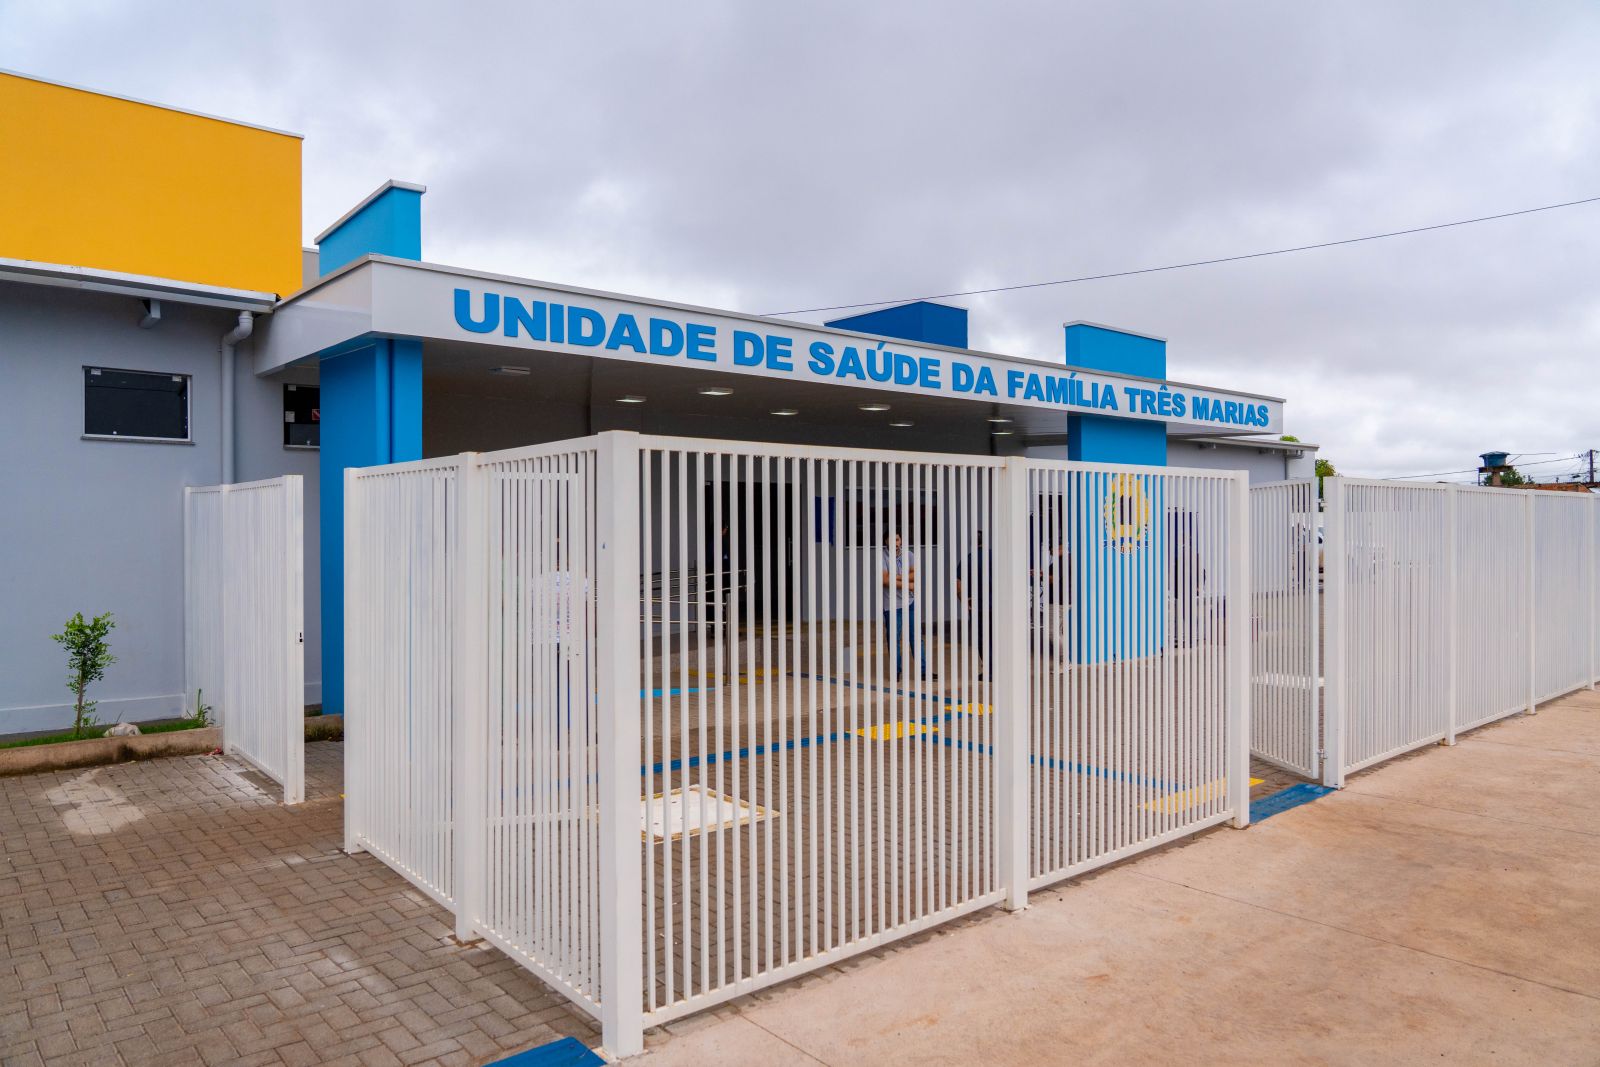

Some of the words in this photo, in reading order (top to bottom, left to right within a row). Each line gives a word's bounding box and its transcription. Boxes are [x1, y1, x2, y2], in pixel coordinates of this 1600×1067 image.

[454, 288, 717, 361] UNIDADE
[733, 329, 793, 371] DE
[807, 340, 941, 389] SAÚDE
[951, 361, 998, 396] DA
[1007, 369, 1118, 410] FAMÍLIA
[1124, 384, 1186, 417] TRÊS
[1191, 396, 1269, 427] MARIAS
